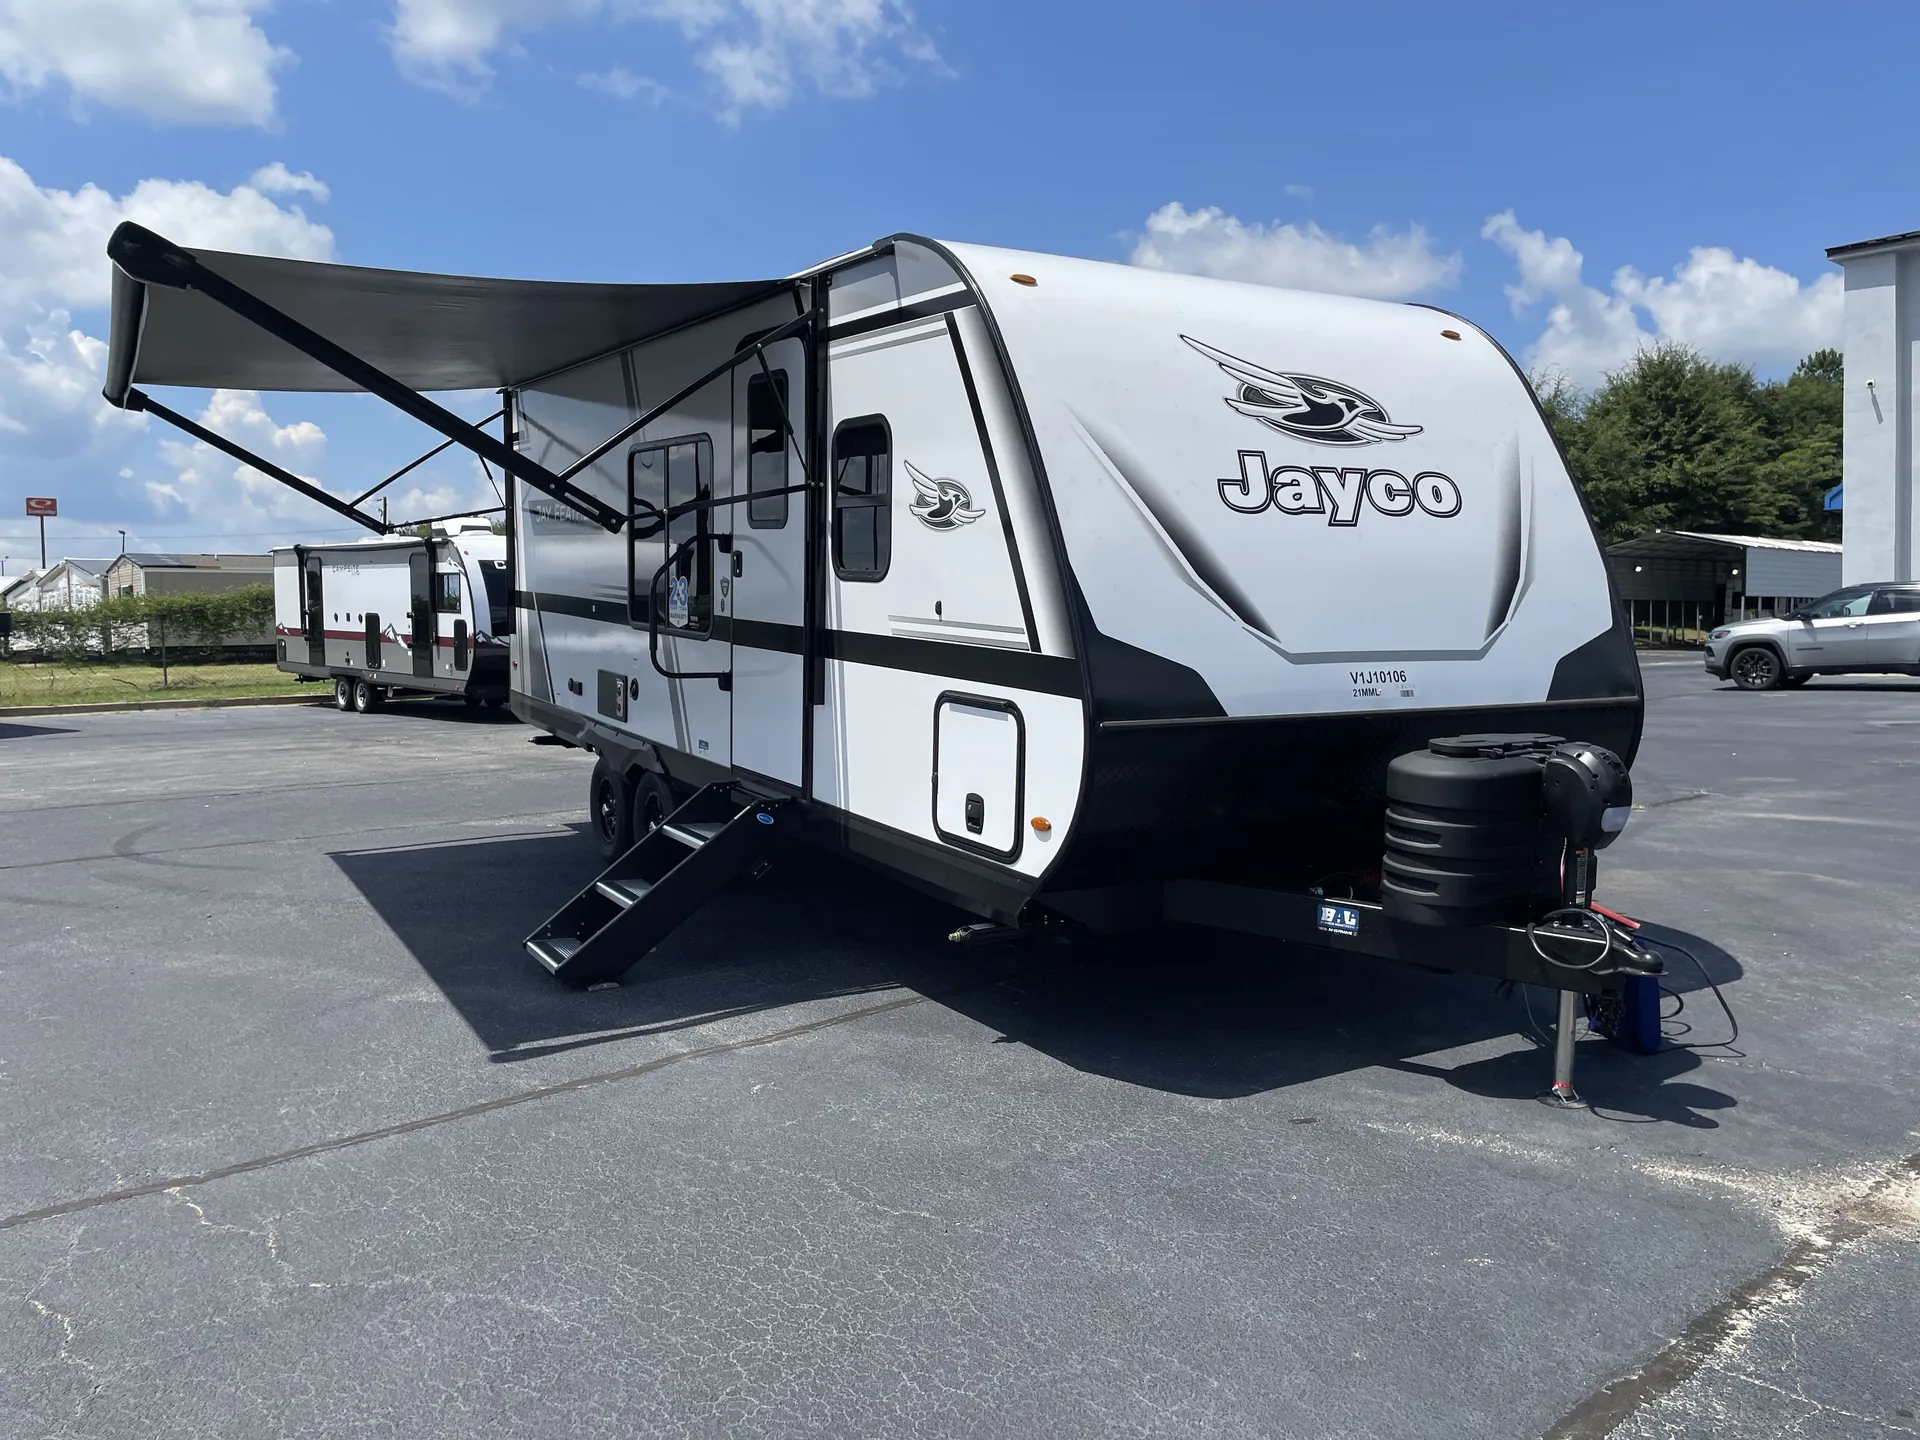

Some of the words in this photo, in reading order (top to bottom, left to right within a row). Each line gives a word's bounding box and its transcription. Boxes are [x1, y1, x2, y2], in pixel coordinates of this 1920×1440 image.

[1217, 449, 1463, 527] Jayco
[535, 505, 552, 523] JAY
[1349, 670, 1407, 684] V1J10106
[1352, 688, 1381, 697] 21MML
